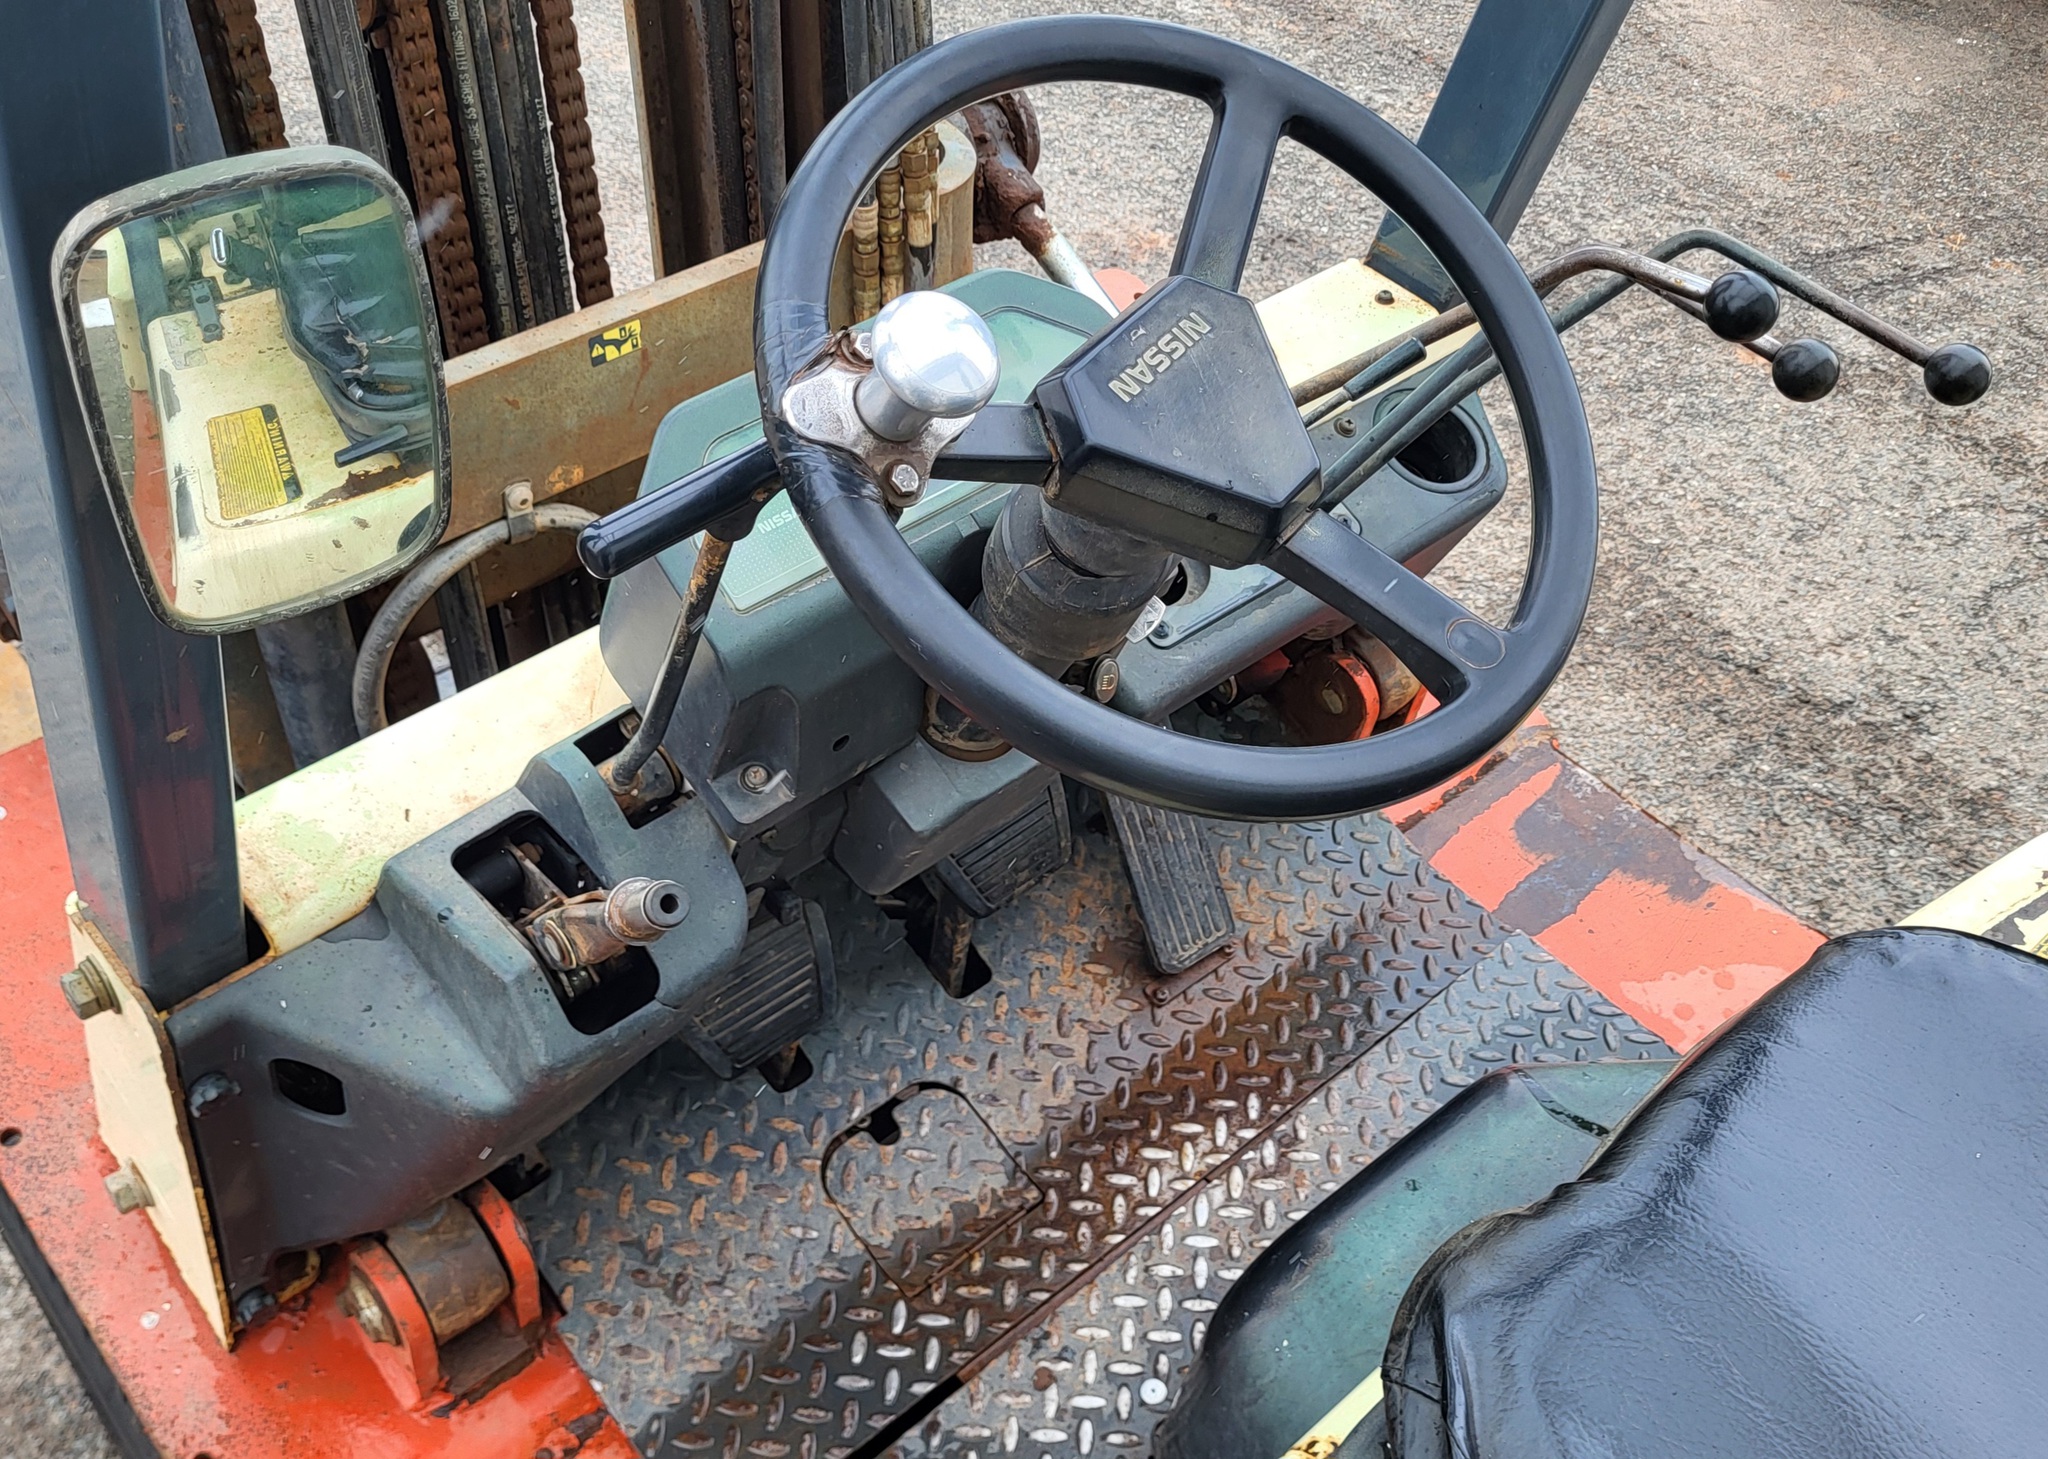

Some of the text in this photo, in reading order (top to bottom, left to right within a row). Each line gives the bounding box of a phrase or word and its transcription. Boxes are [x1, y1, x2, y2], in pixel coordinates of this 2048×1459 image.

[460, 72, 474, 105] SERIES
[466, 107, 477, 120] 55
[479, 181, 489, 195] PSI
[1108, 312, 1212, 403] NISSAN
